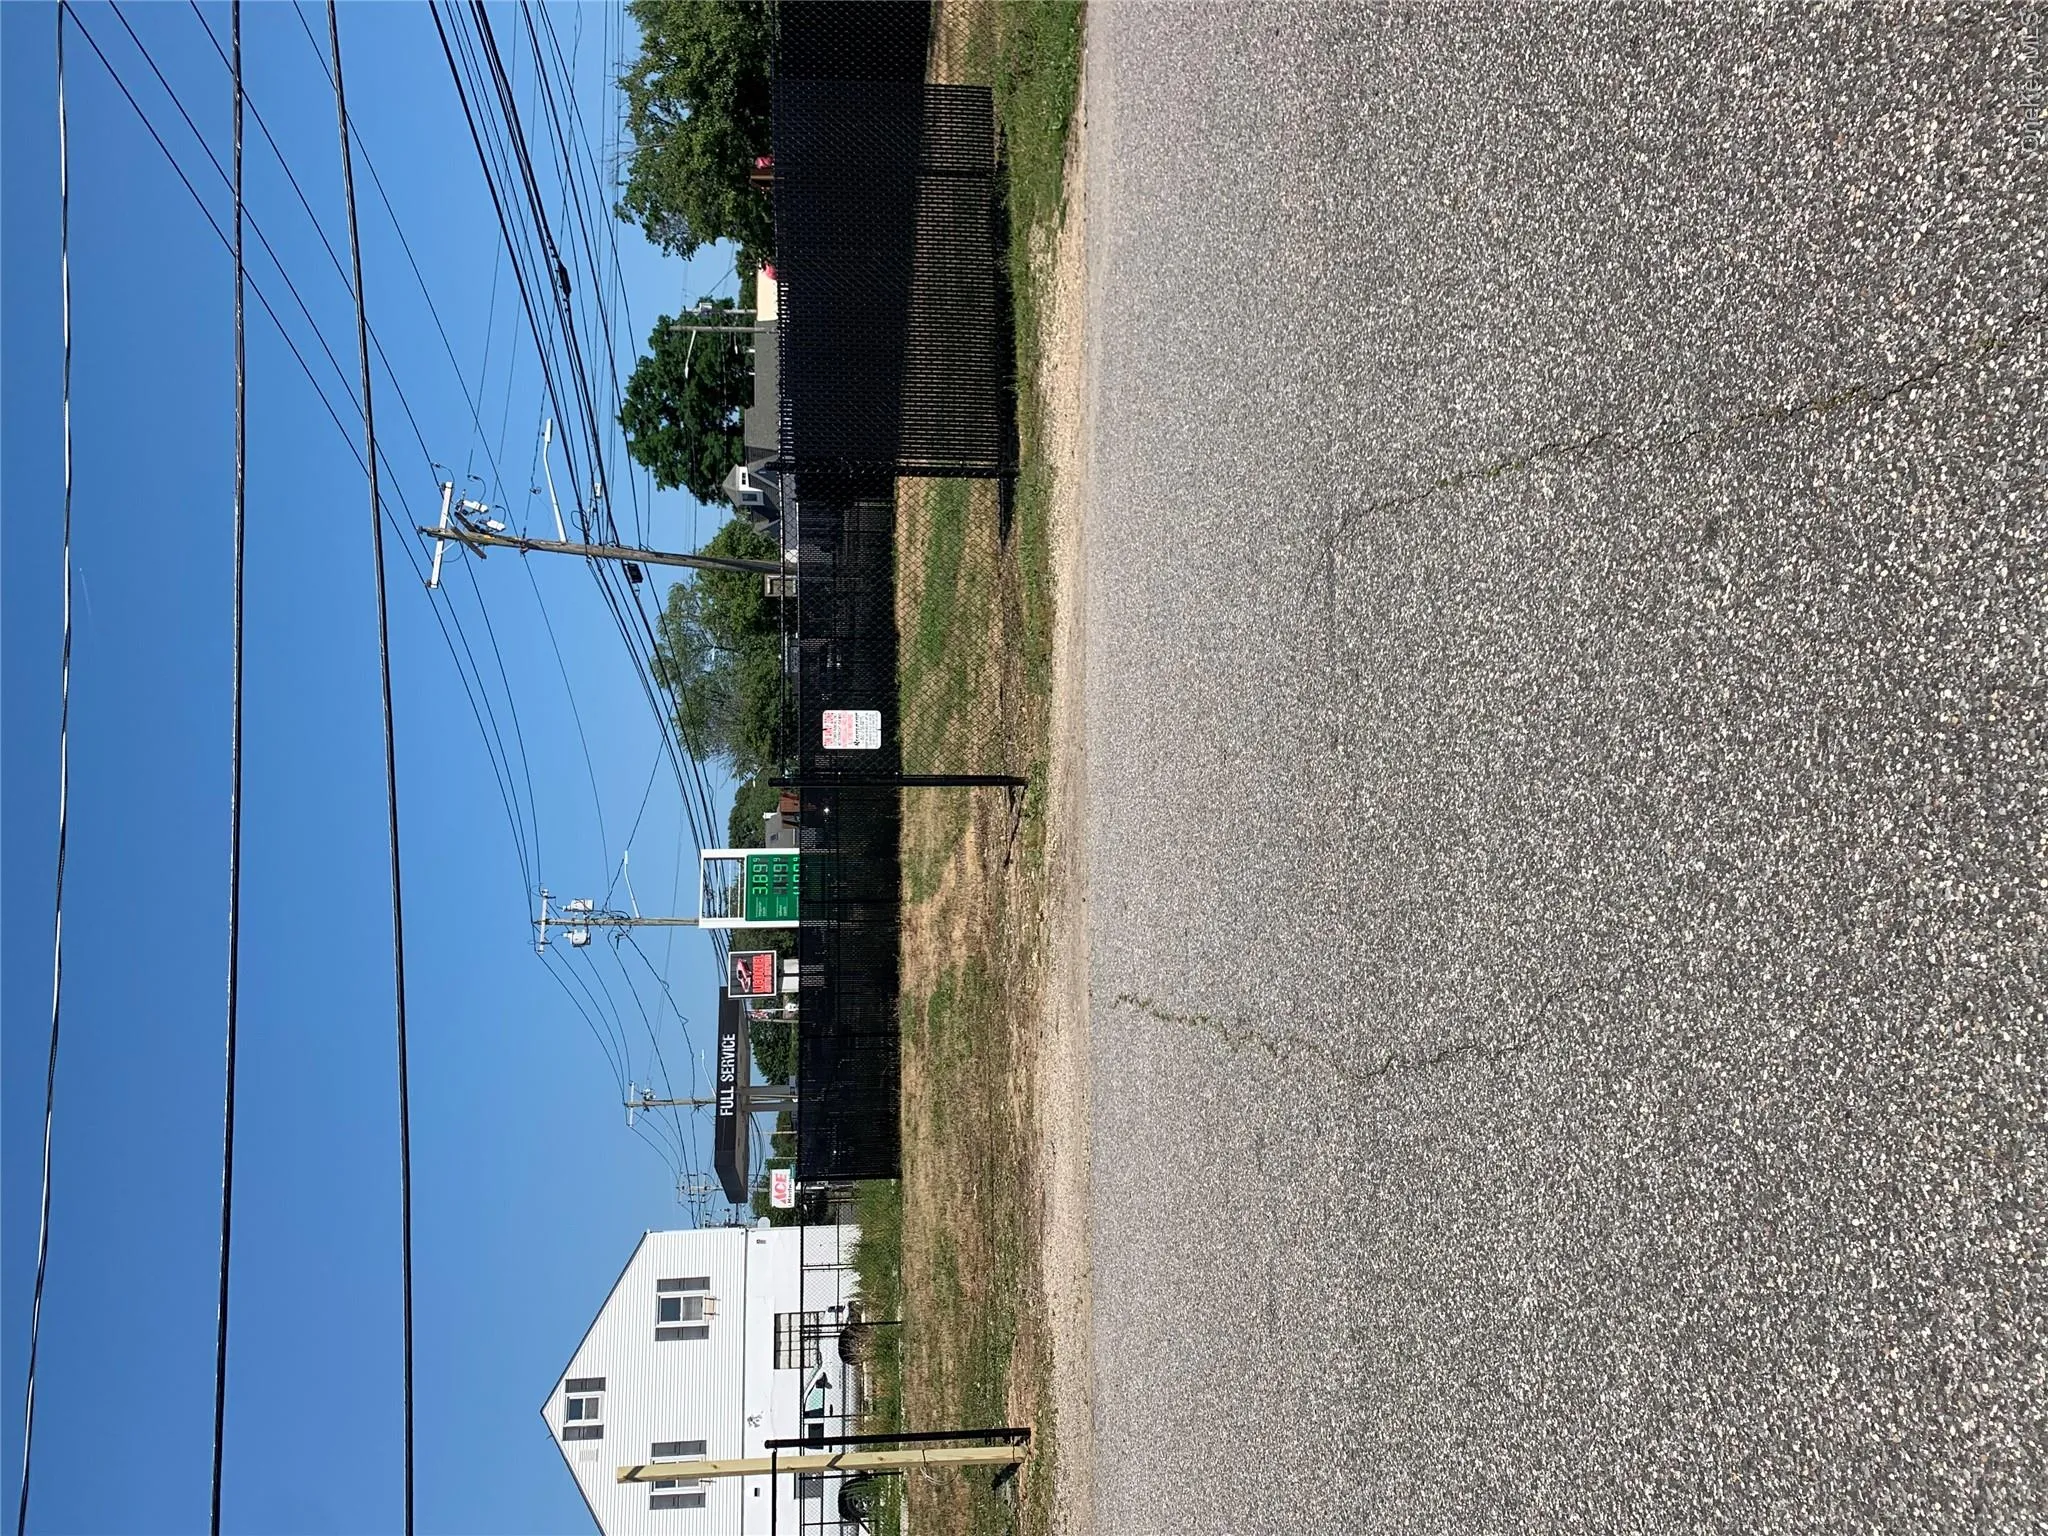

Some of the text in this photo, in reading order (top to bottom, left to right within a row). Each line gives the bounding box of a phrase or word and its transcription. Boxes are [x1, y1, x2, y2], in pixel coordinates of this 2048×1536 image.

[720, 1034, 736, 1116] FULL SERVICE
[774, 1173, 787, 1204] ACE
